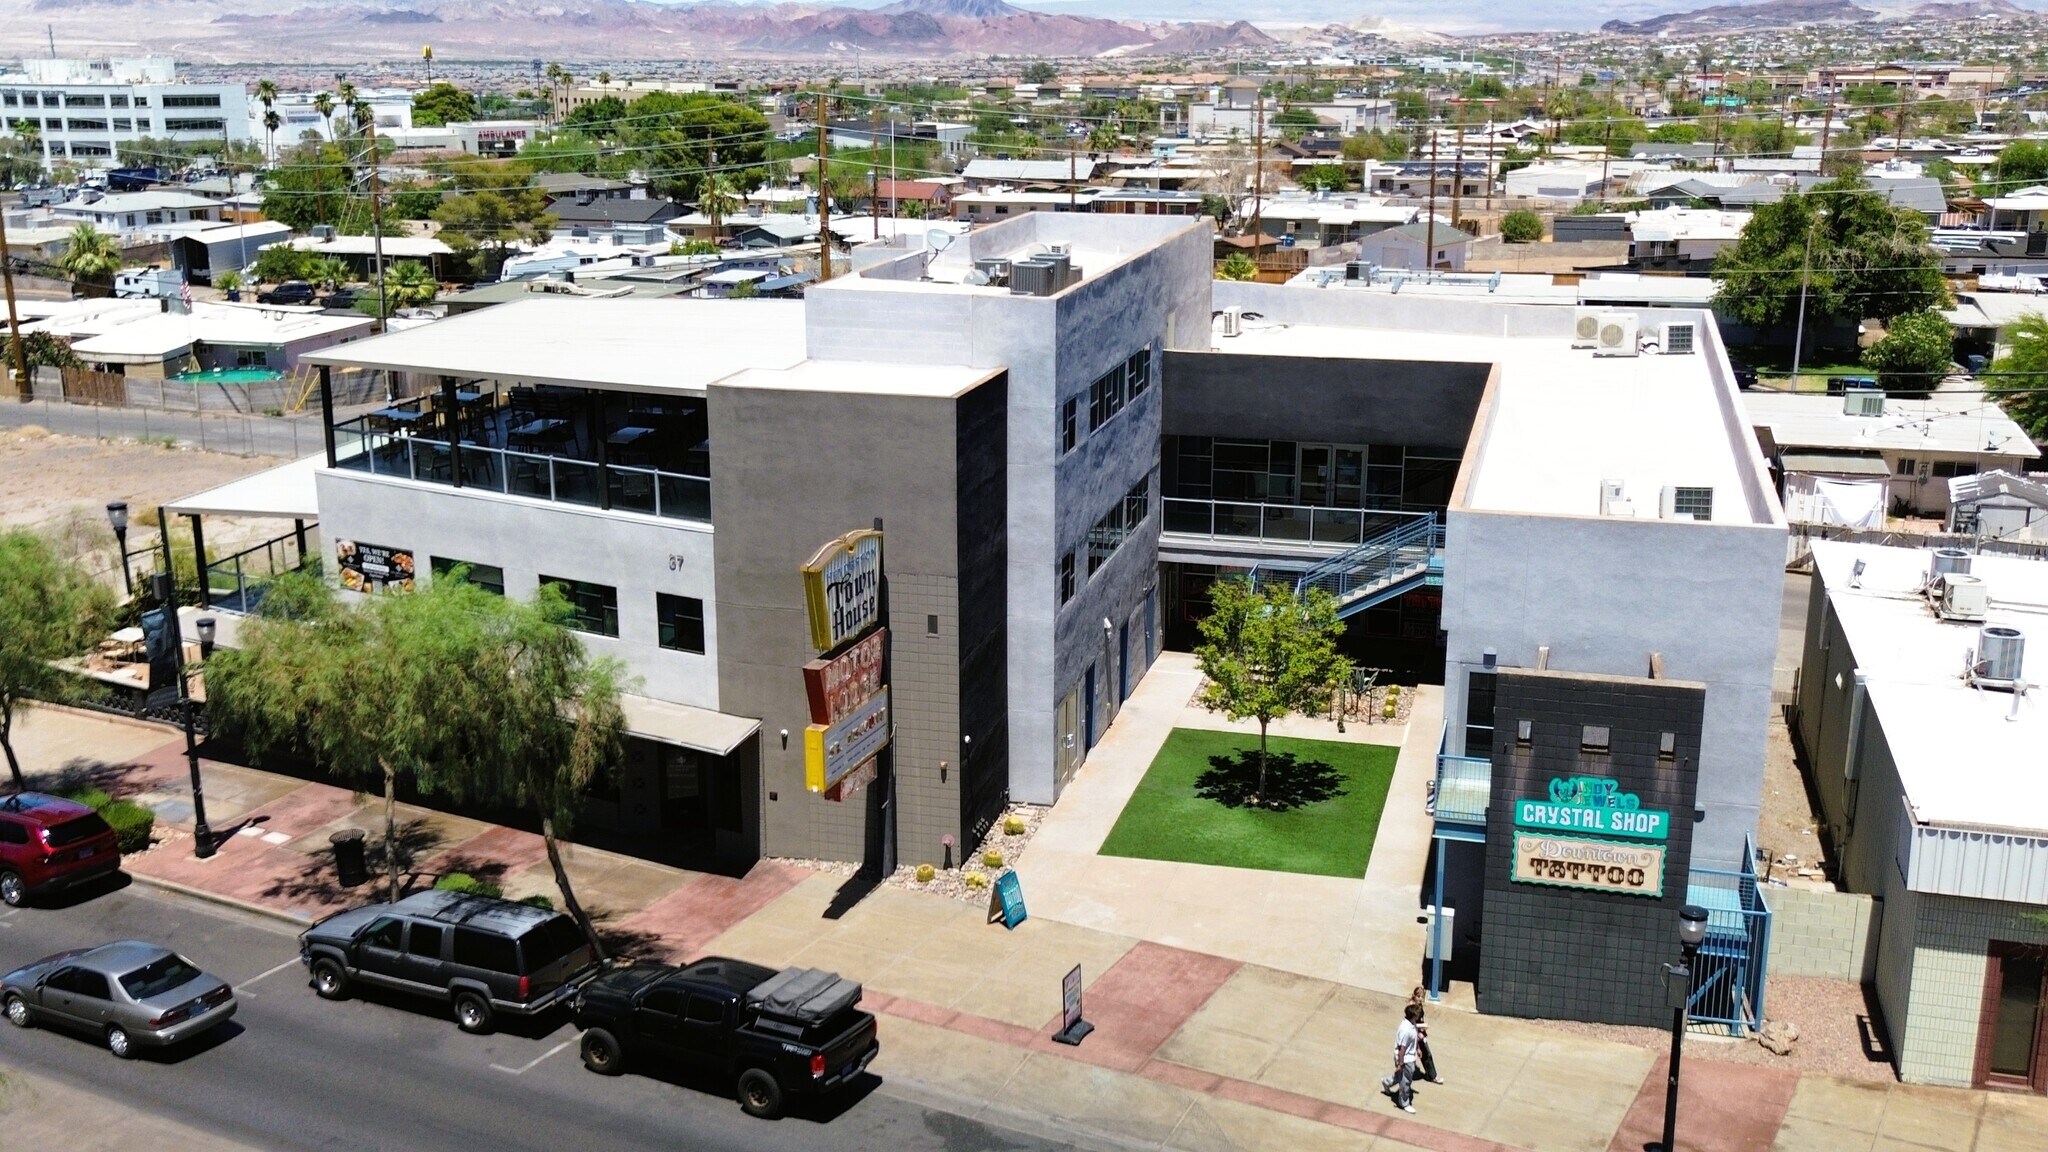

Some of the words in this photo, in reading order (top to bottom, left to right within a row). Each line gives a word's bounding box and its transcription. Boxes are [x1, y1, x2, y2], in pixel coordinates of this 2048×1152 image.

[478, 130, 527, 139] AMBULANCE
[826, 548, 876, 581] HENDERSON
[826, 569, 876, 609] Town
[832, 596, 875, 641] House
[825, 635, 881, 693] MOTOR
[1576, 793, 1636, 811] JEWELS
[1522, 803, 1604, 829] CRYSTAL
[1610, 811, 1660, 833] SHOP
[1530, 839, 1645, 867] Downtown
[1530, 857, 1645, 886] TATTOO
